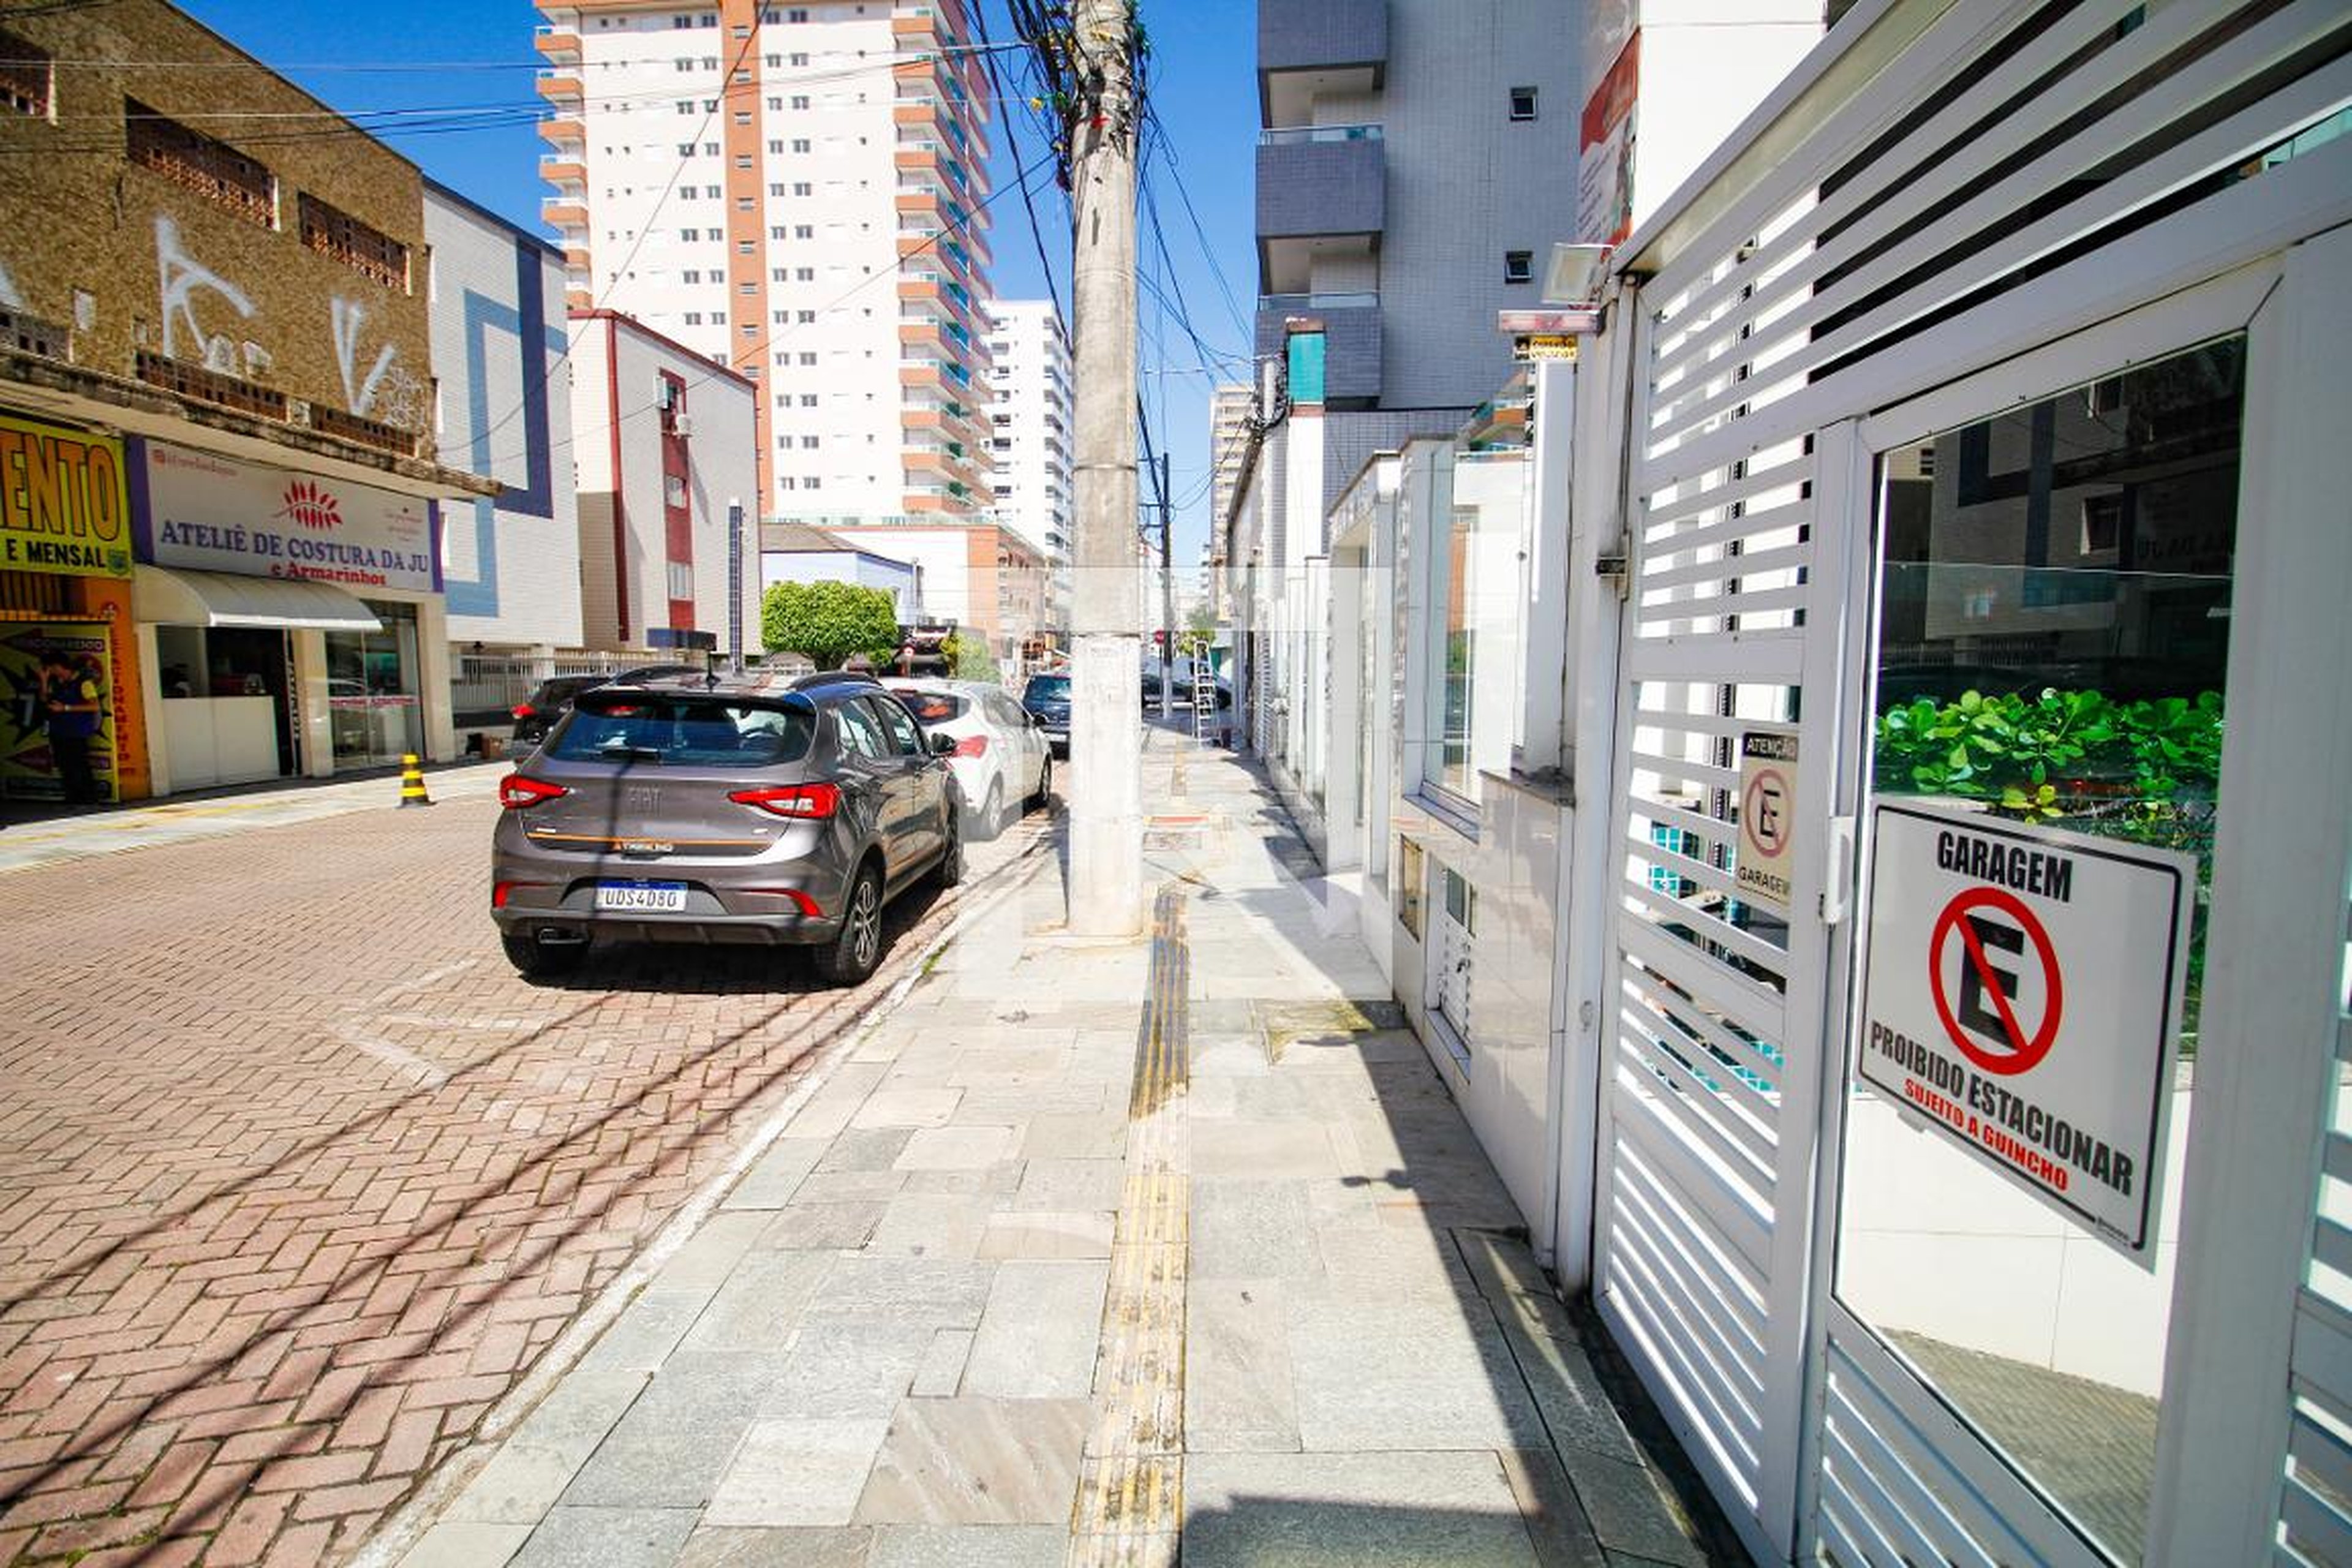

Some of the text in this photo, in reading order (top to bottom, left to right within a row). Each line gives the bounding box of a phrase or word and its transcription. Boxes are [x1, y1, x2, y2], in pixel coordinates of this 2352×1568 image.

[6, 538, 107, 568] E MENSAL
[160, 519, 428, 572] ATELIÊ DE COSTURA DA JU
[271, 561, 386, 585] e Armarinhos
[1746, 737, 1796, 760] ATENÇÃO
[1738, 866, 1790, 895] GARAGEM
[1937, 829, 2073, 903] GARAGEM
[1870, 1019, 2133, 1197] PROIBIDO ESTACIONAR
[1904, 1078, 2069, 1192] SUJEITO A GUINCHO
